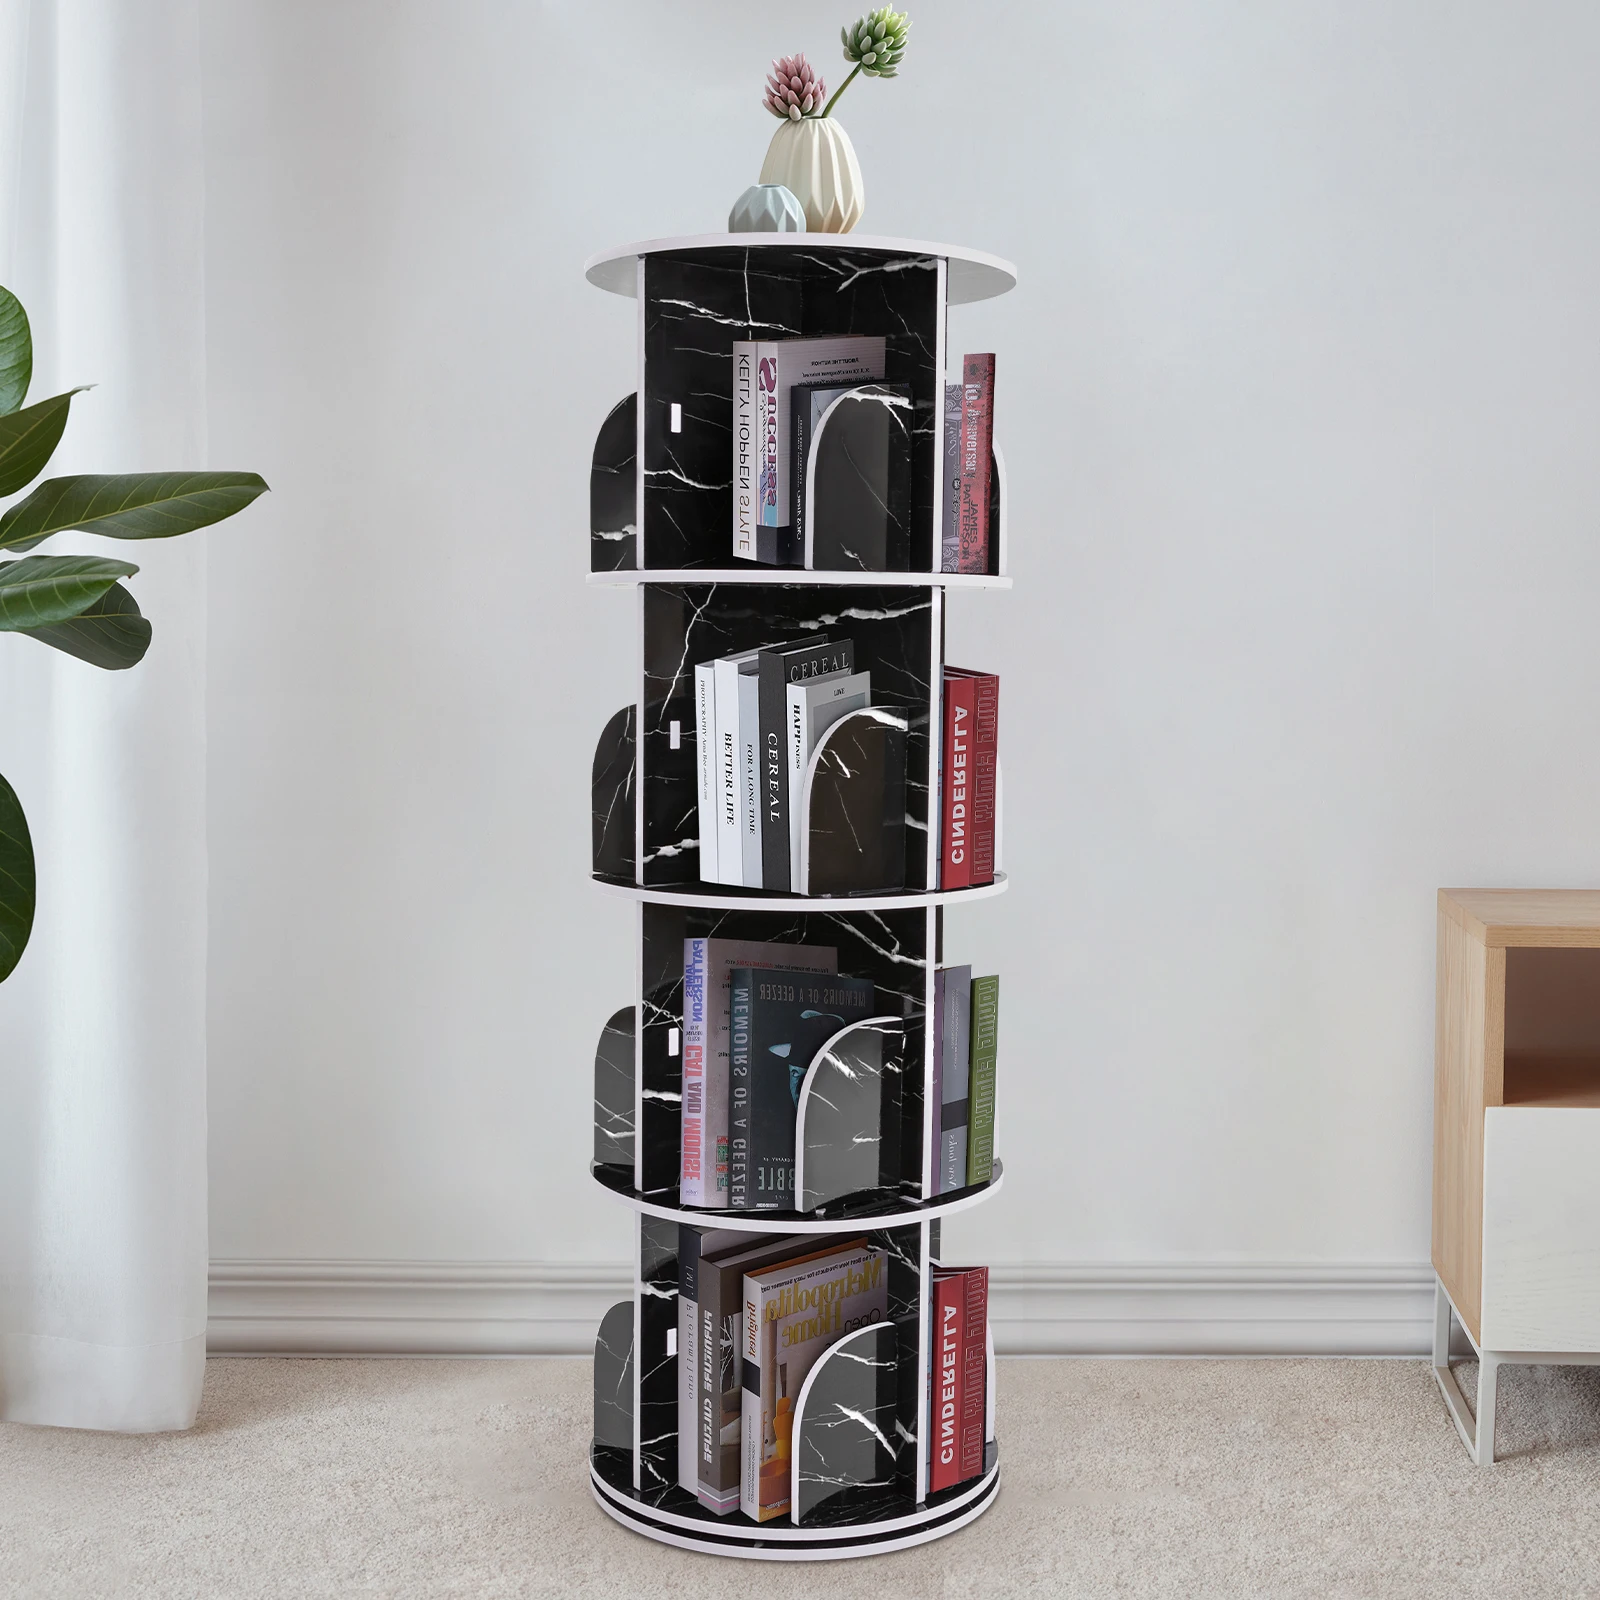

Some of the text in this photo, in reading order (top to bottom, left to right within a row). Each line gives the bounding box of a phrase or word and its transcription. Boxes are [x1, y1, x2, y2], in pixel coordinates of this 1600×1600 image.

[963, 409, 982, 479] Anniversary
[961, 483, 971, 560] PATTERSON
[970, 500, 979, 544] JAMES
[790, 651, 849, 682] CEREAL
[746, 742, 754, 765] FOR
[724, 732, 735, 826] BETTER LIFE
[747, 776, 755, 806] LONG
[768, 732, 780, 823] CEREAL
[748, 808, 756, 836] TIME
